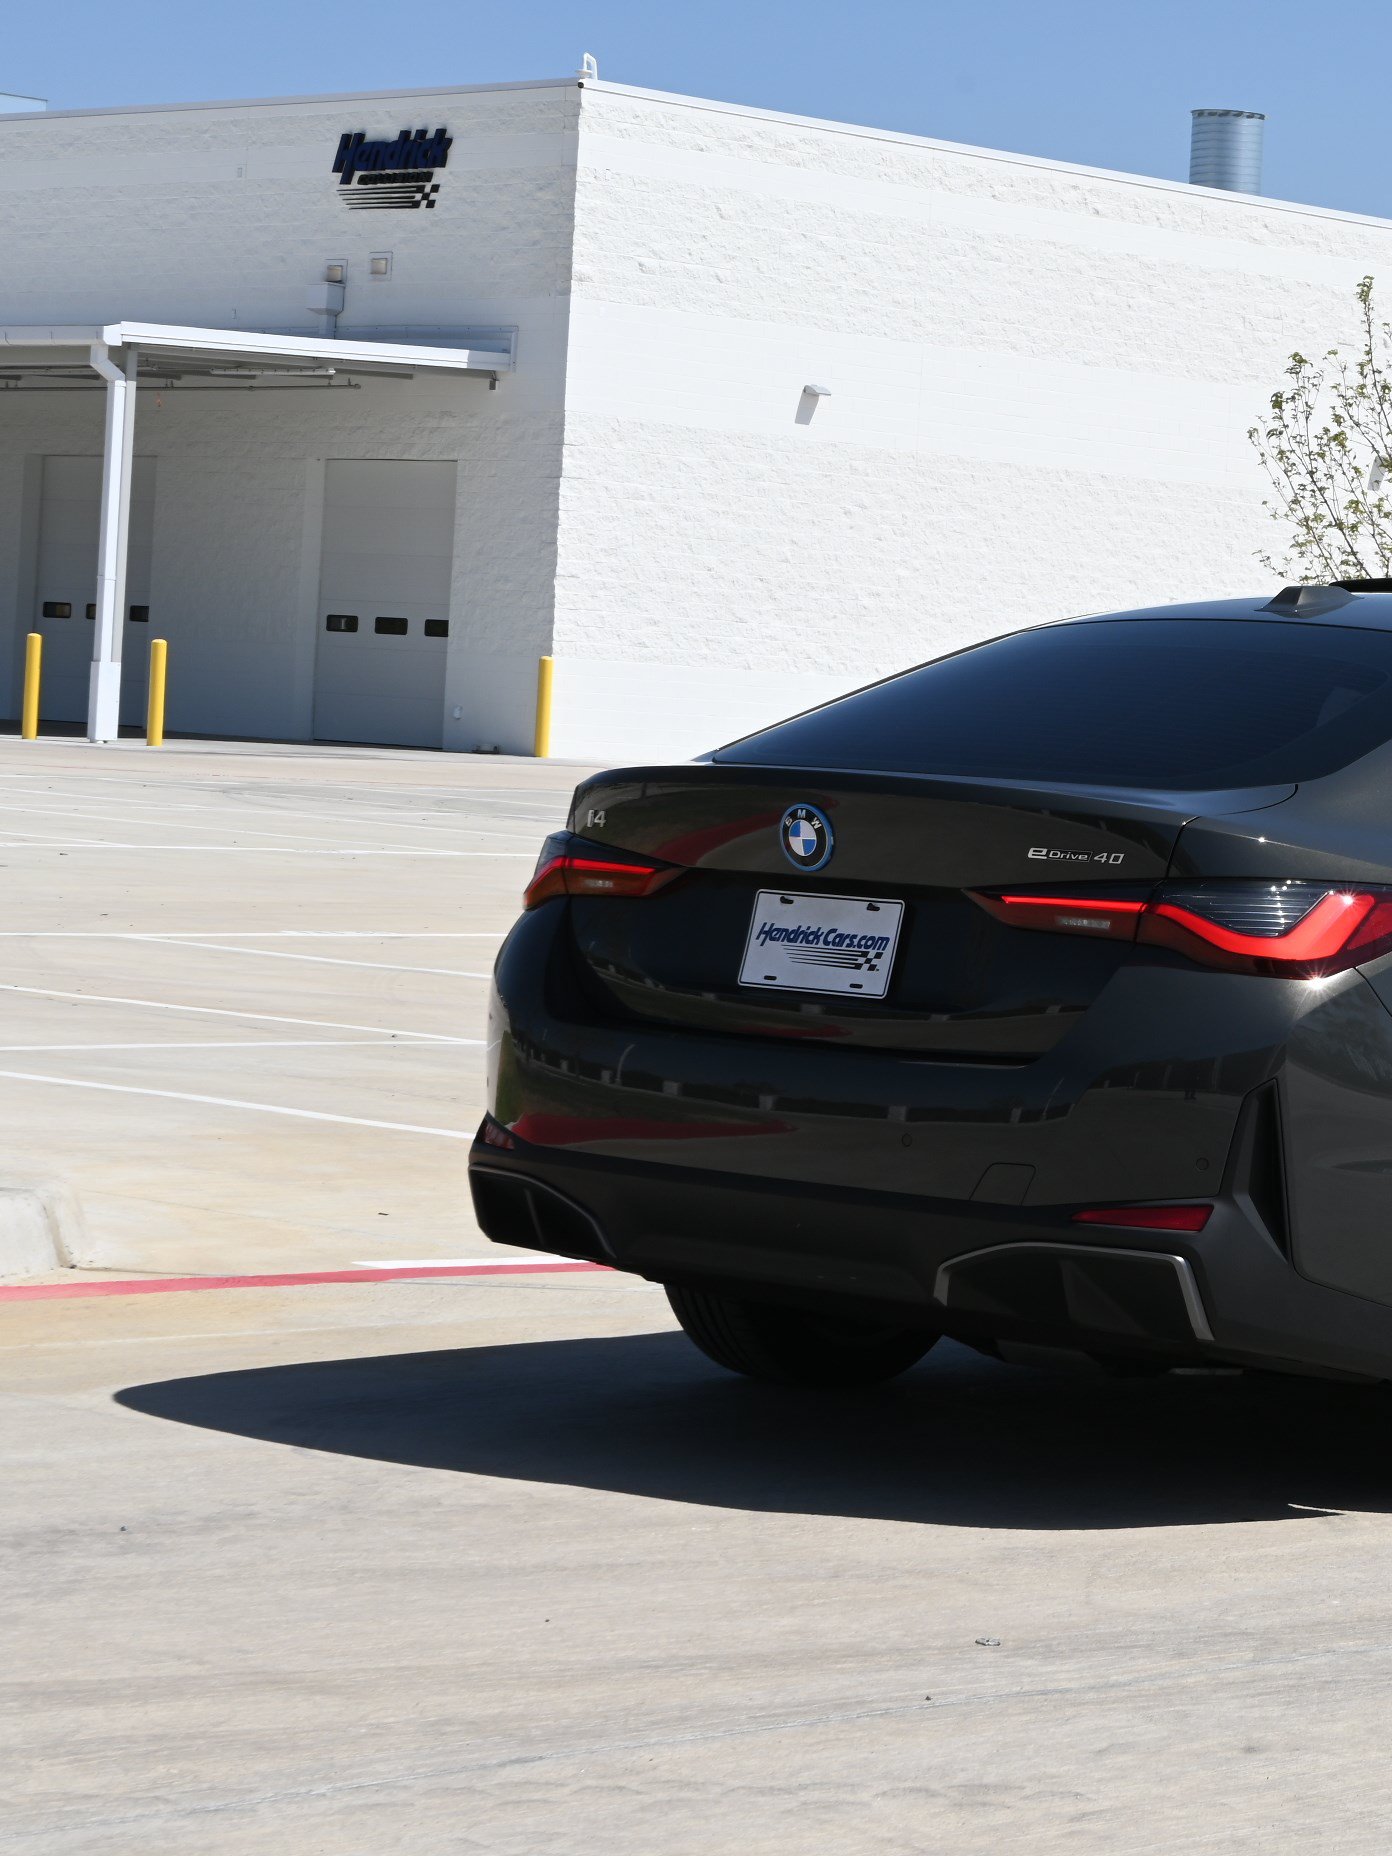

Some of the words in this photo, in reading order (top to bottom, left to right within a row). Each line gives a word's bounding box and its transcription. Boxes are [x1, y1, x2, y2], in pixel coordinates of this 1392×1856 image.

[332, 128, 453, 185] Hendrick
[784, 808, 823, 830] BMW
[1027, 847, 1091, 863] eDrive
[1094, 852, 1125, 865] 40
